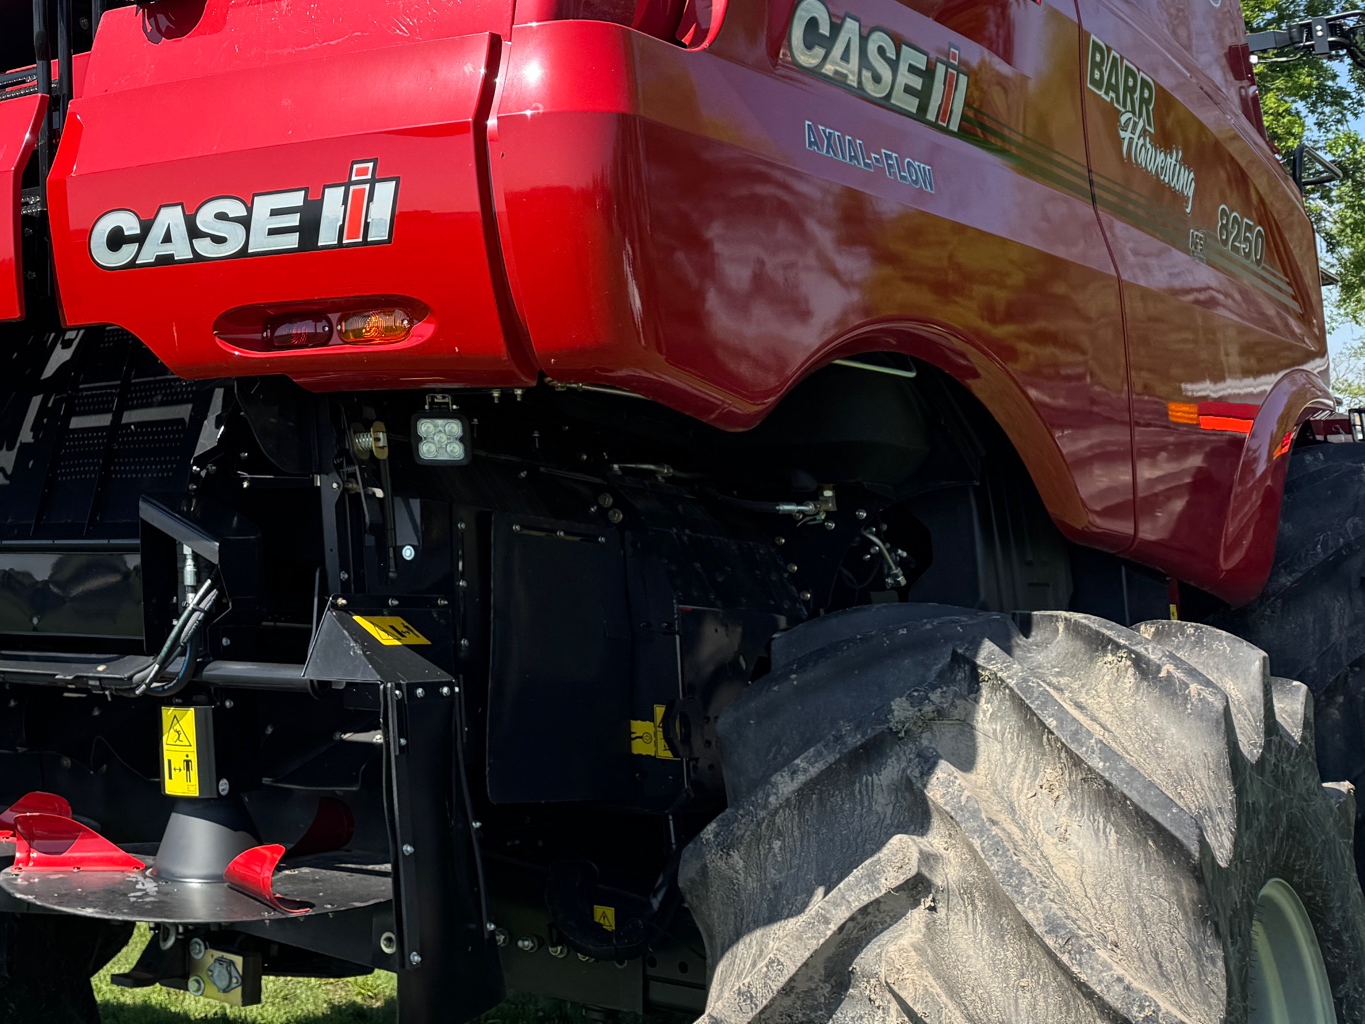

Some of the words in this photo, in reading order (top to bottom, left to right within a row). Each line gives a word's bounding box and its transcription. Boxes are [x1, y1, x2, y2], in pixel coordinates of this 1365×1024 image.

[1087, 33, 1156, 134] BARR
[805, 120, 935, 194] AXIAL-FLOW
[1118, 110, 1196, 216] Harvesting
[89, 190, 306, 268] CASE
[1217, 204, 1265, 269] 8250
